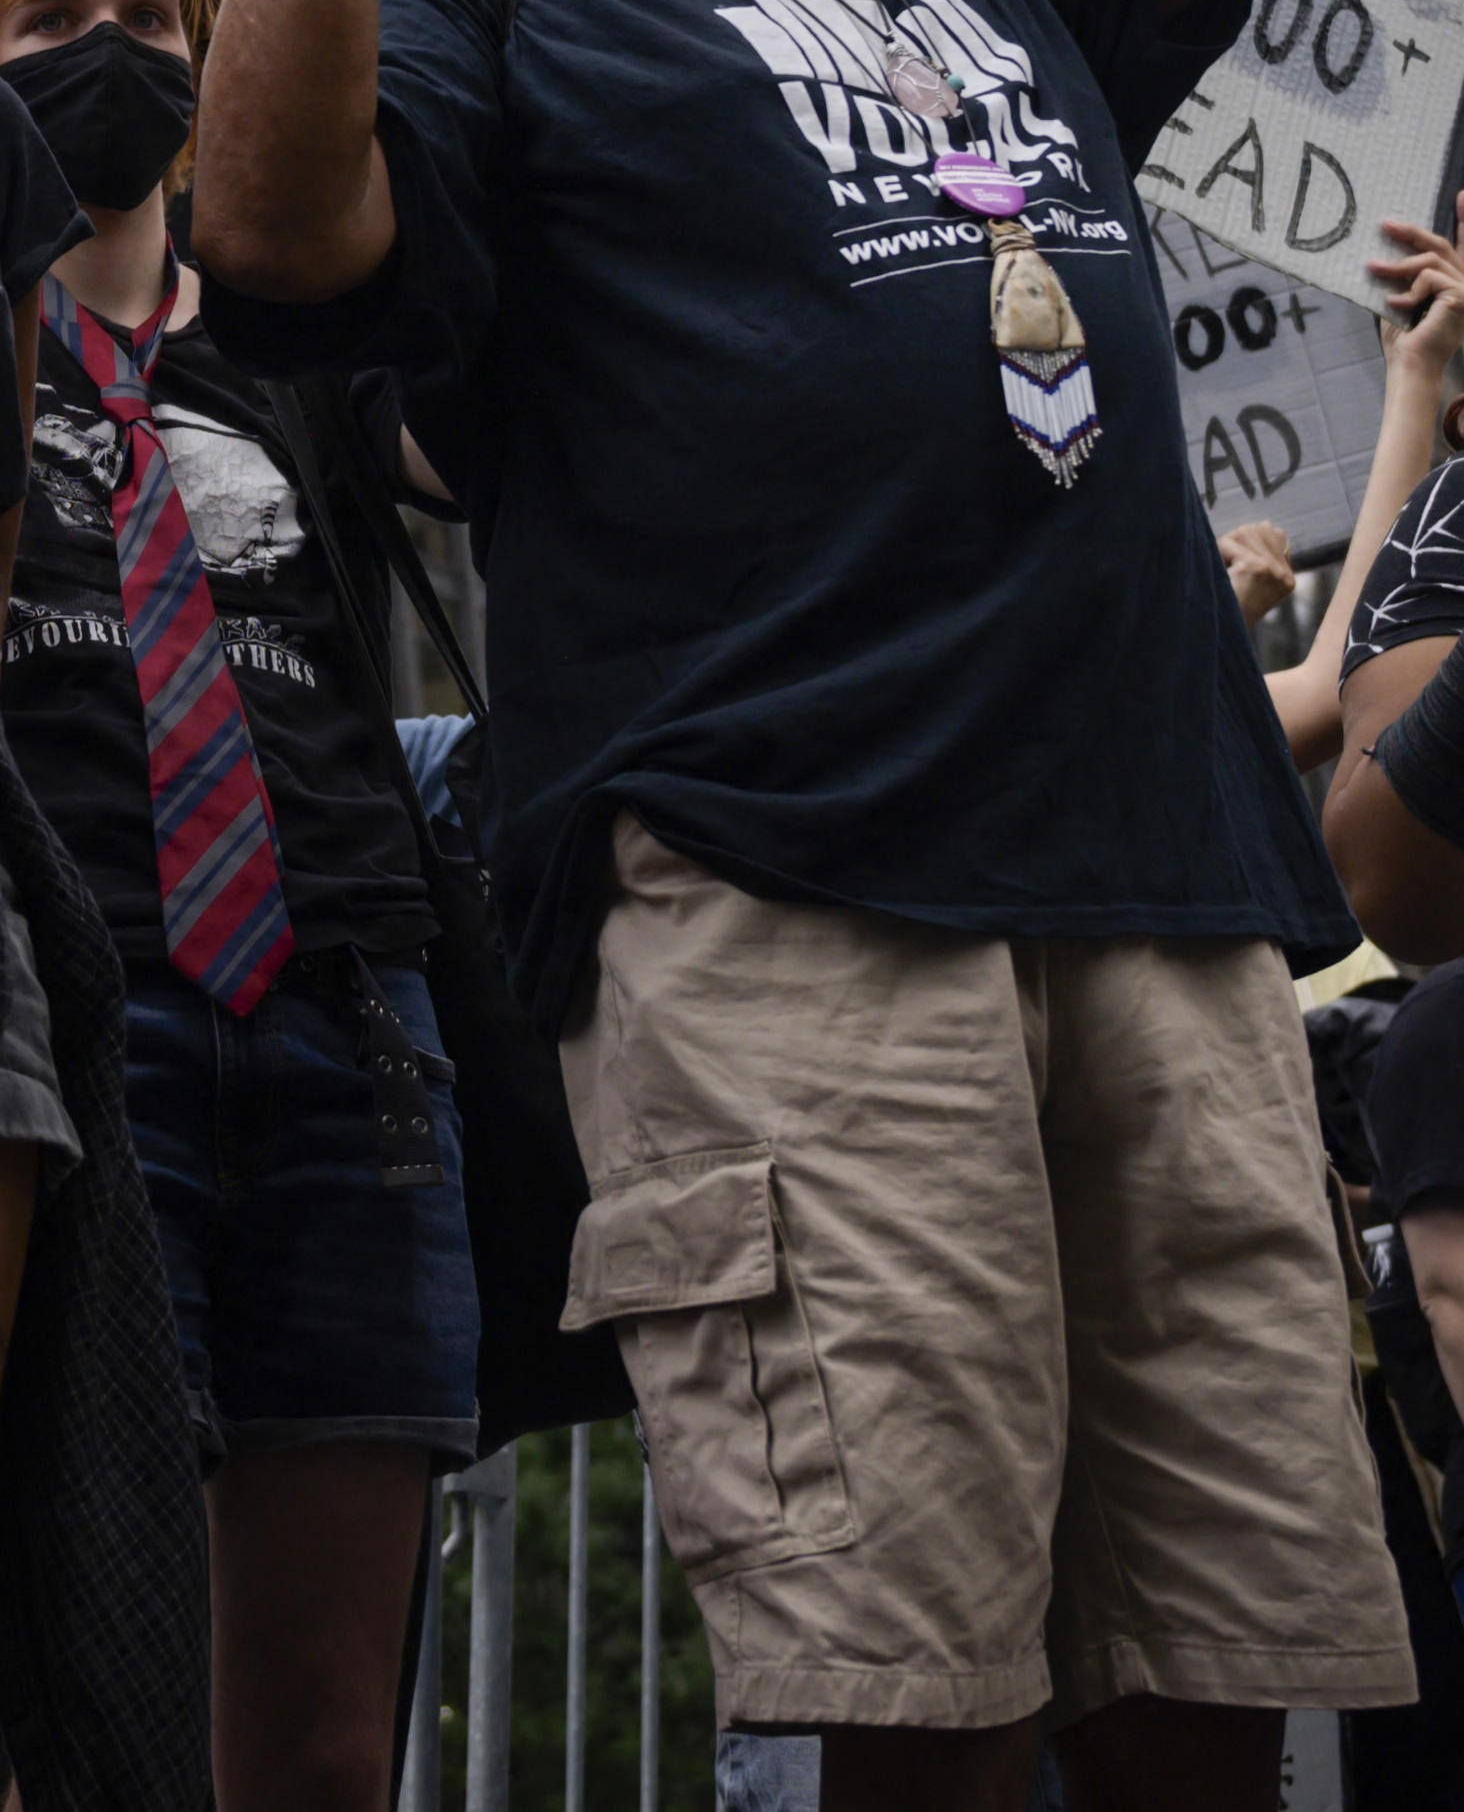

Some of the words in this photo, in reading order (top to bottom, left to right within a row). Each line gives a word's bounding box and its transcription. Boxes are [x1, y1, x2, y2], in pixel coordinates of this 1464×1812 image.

[1139, 89, 1358, 253] EAD
[840, 207, 1129, 265] www.VOL-NY.org
[0, 619, 131, 664] EVOURI
[228, 643, 316, 688] THERS
